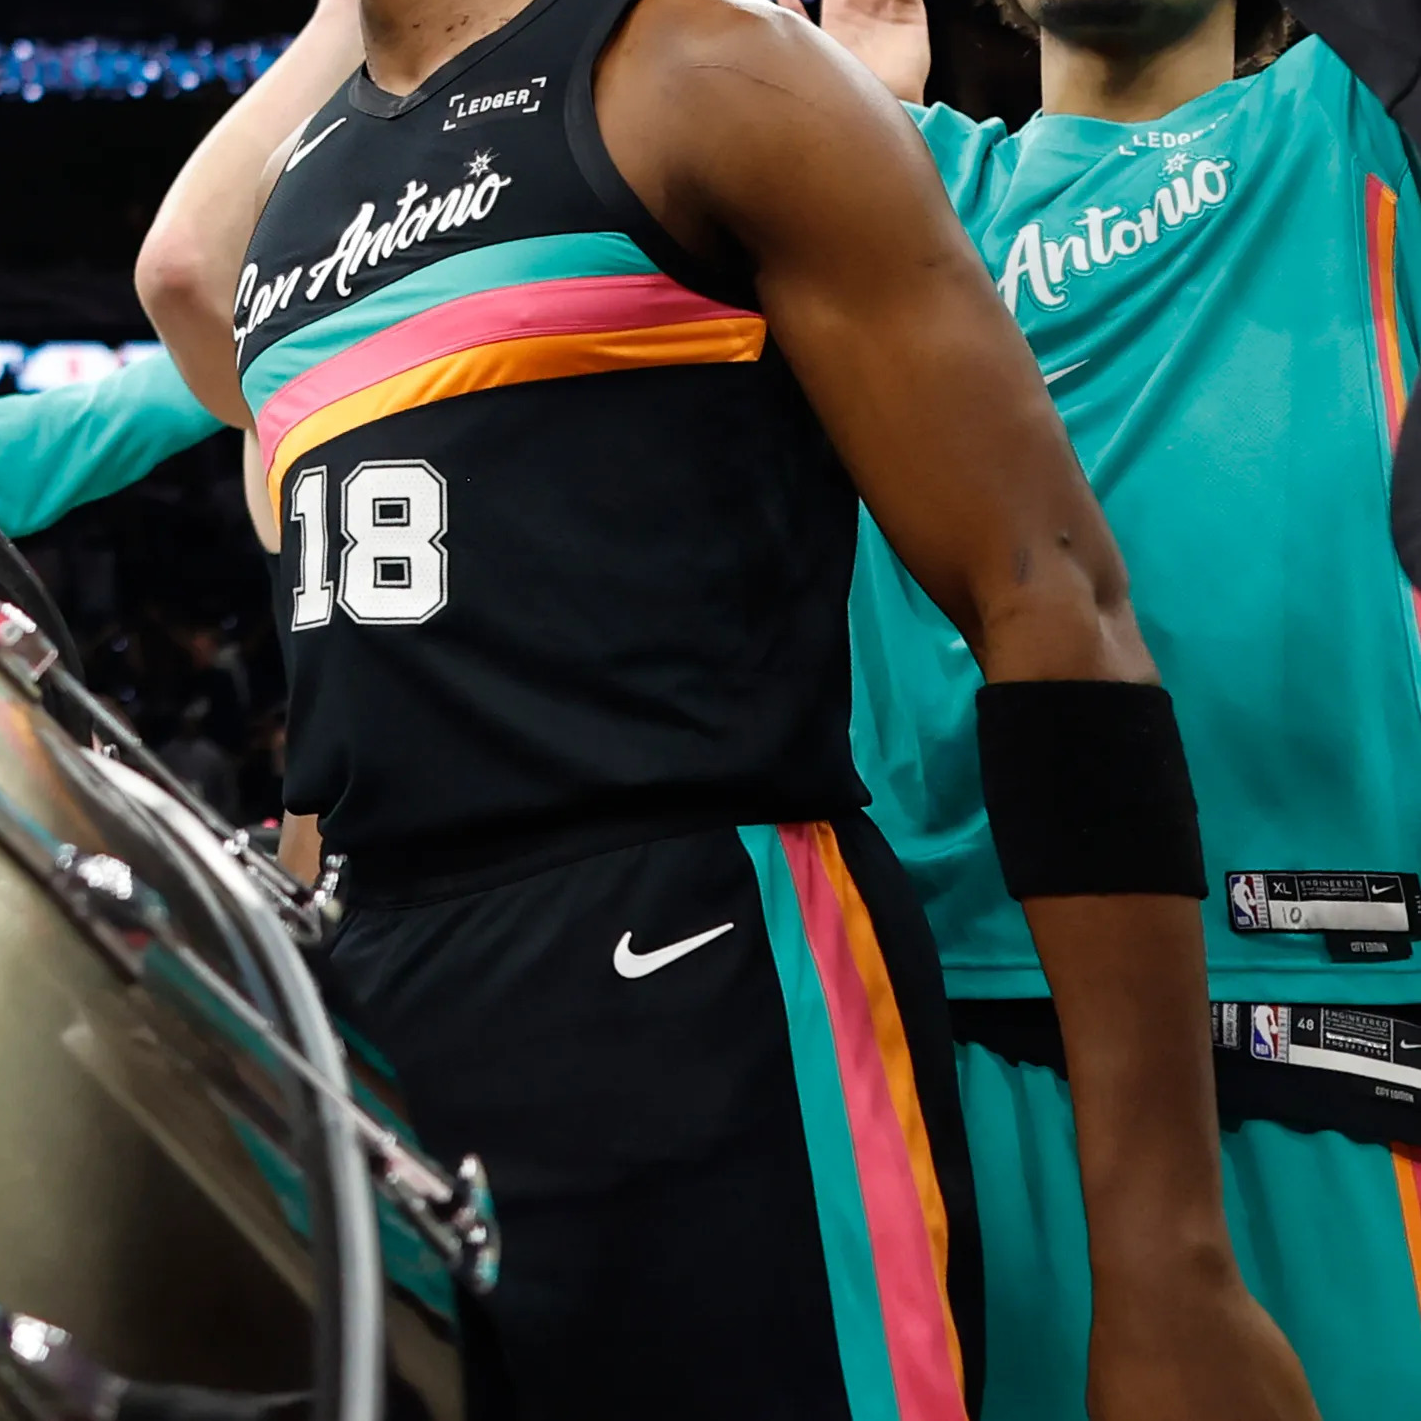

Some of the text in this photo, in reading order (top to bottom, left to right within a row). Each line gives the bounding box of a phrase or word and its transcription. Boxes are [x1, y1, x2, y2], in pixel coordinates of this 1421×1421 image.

[457, 87, 531, 118] LEDGER
[305, 153, 512, 301] Antonio
[997, 153, 1232, 317] Antonio
[291, 458, 449, 632] 18
[1272, 881, 1293, 895] XL
[1297, 1017, 1315, 1031] 48
[1324, 1009, 1389, 1028] ENGINEERED
